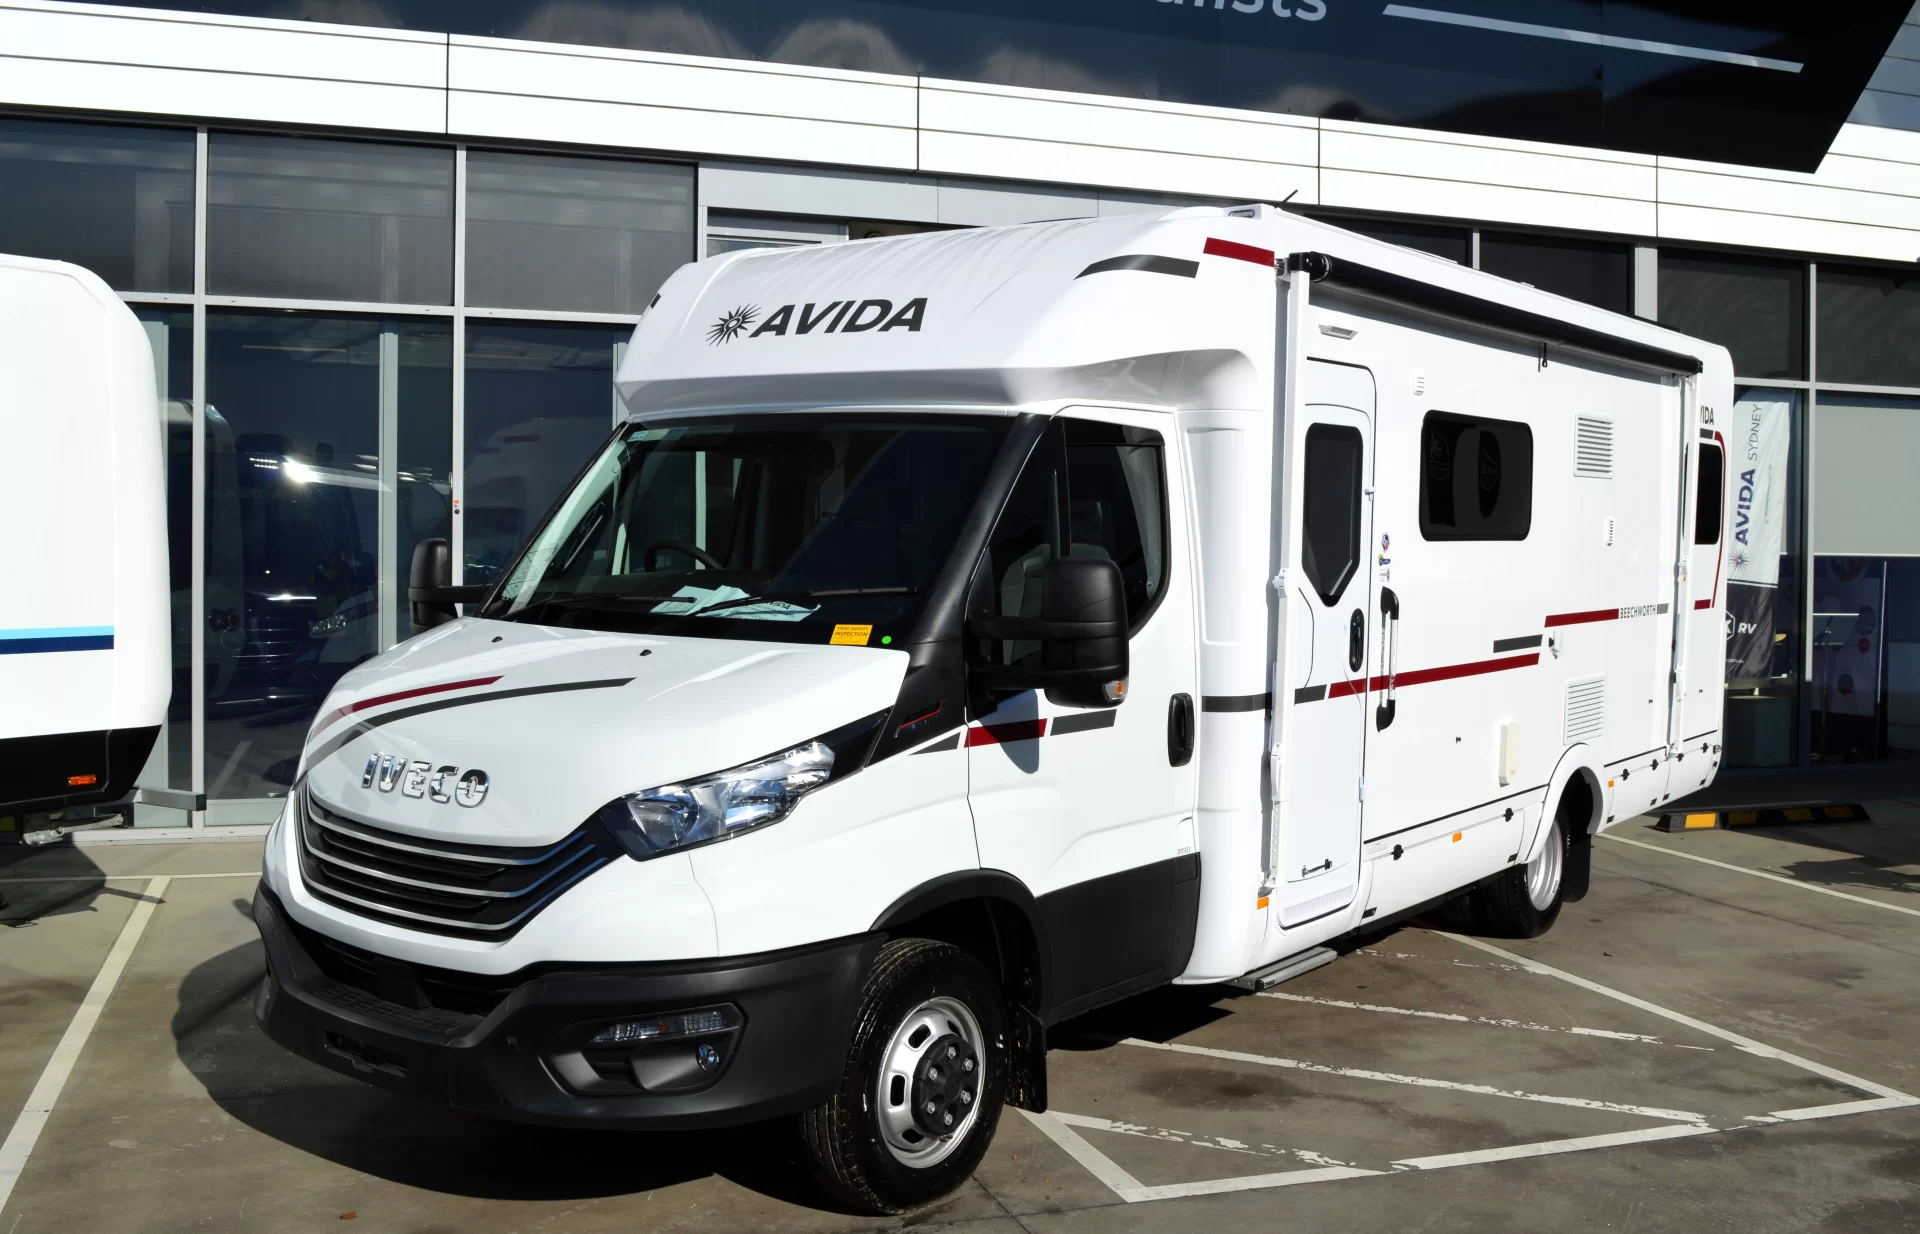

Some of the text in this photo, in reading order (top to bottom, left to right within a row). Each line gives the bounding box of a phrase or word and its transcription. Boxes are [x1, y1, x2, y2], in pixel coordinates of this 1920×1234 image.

[748, 297, 928, 338] AVIDA
[1735, 403, 1762, 546] AVIDA SYDNEY
[1620, 604, 1657, 619] BEECHWORTH
[1737, 622, 1758, 635] RV
[361, 752, 489, 808] IVECO
